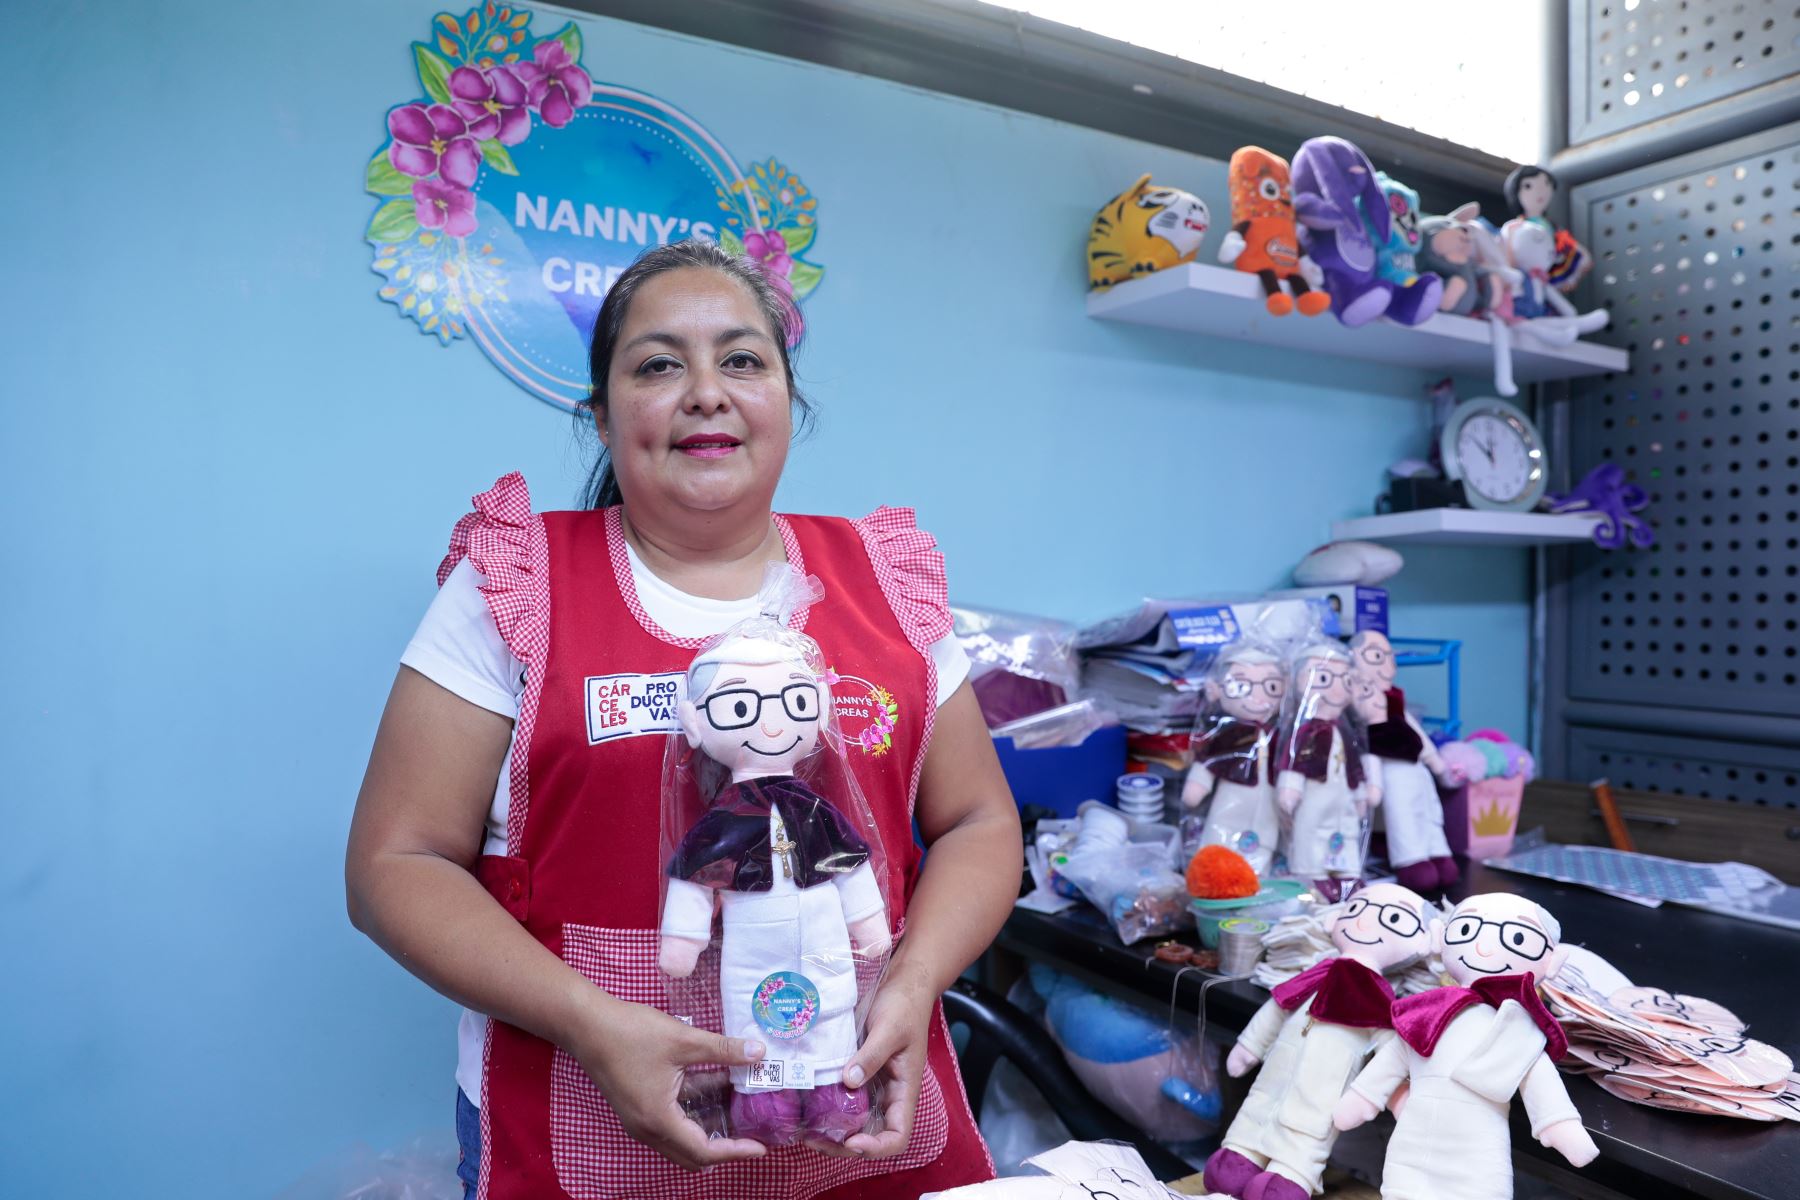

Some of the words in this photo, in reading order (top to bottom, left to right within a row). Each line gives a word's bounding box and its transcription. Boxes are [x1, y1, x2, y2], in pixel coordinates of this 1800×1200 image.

[542, 257, 625, 298] CRE
[598, 680, 631, 699] CÁR
[646, 681, 677, 695] PRO
[599, 699, 619, 713] CE
[836, 707, 869, 718] CREAS
[600, 711, 628, 729] LES
